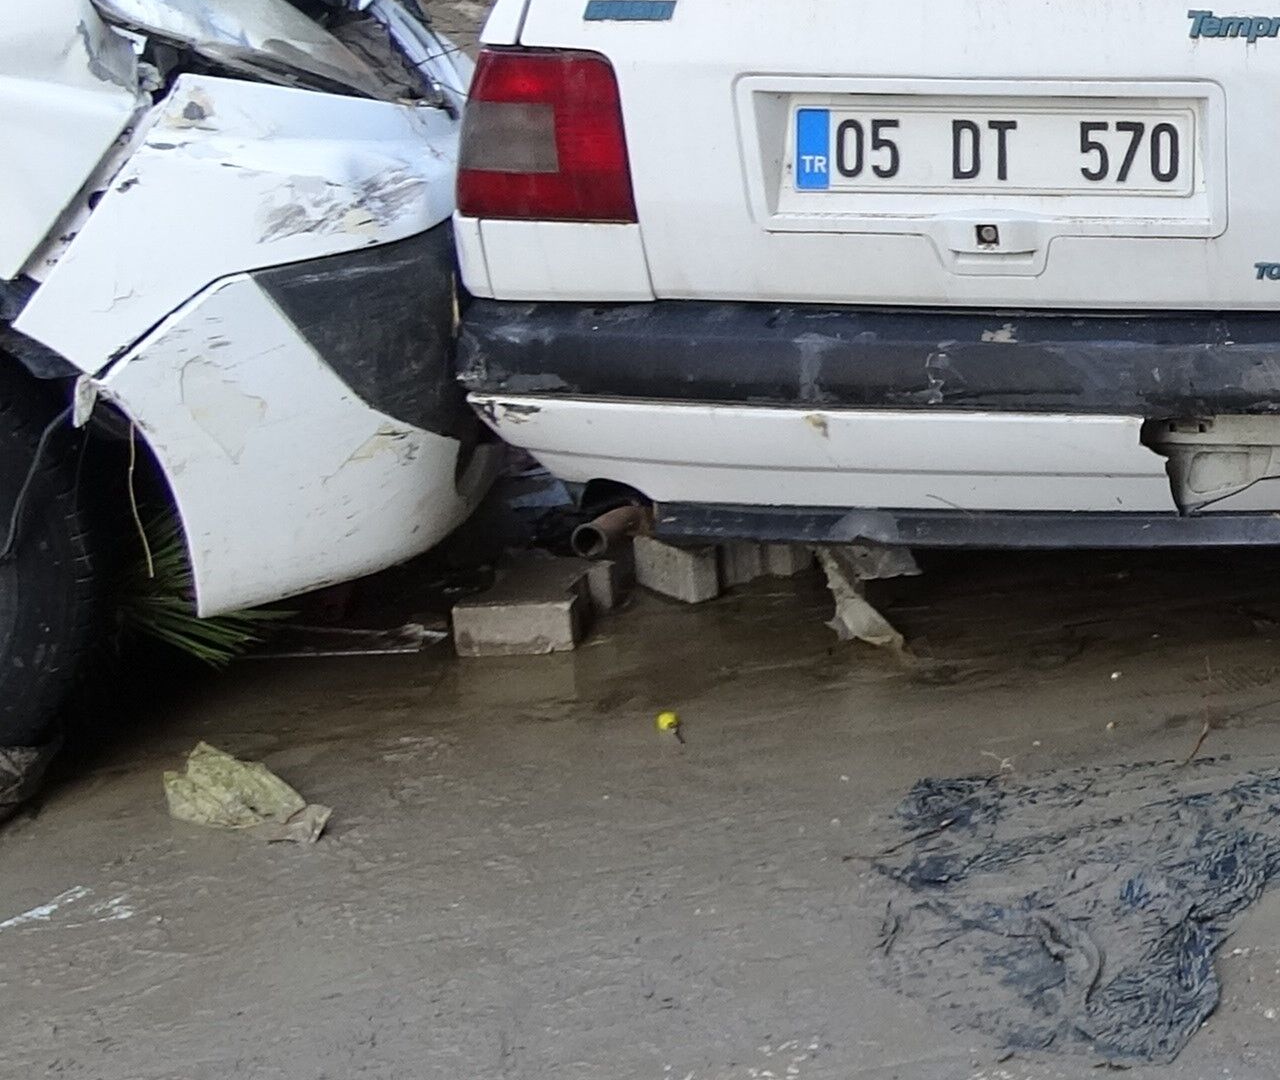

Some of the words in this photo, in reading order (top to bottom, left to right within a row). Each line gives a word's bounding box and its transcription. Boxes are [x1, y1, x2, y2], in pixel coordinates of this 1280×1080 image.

[801, 155, 826, 174] TR
[835, 118, 900, 179] 05
[952, 119, 1018, 181] DT
[1079, 120, 1180, 183] 570
